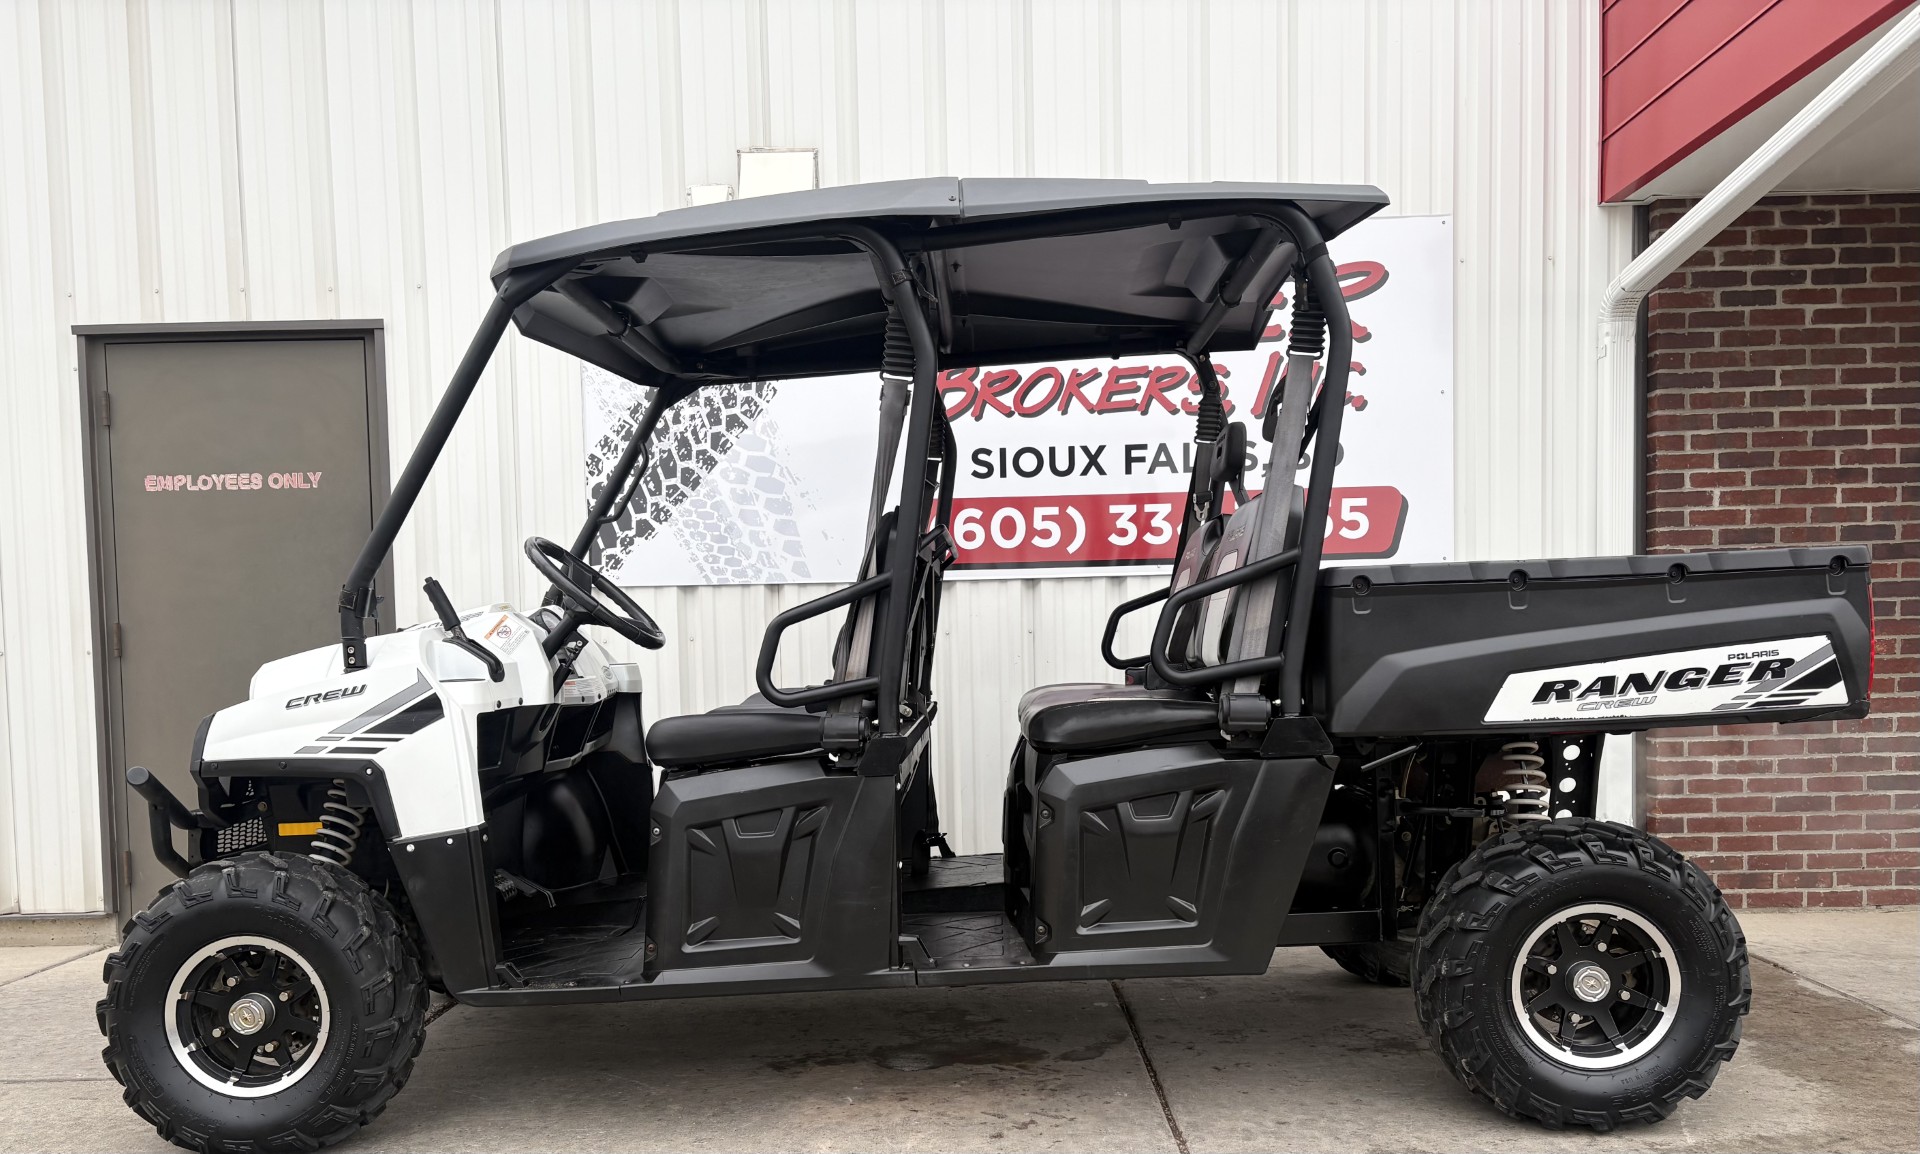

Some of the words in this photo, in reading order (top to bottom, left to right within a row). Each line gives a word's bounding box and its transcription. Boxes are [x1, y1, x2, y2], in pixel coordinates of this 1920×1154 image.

[937, 364, 1237, 424] BROKERS
[971, 443, 1107, 480] SIOUX
[1124, 440, 1271, 477] FALS,
[144, 473, 263, 492] EMPLOYEES
[267, 471, 323, 490] ONLY
[1727, 649, 1780, 661] POLARIS
[1530, 656, 1798, 705] RANGER
[285, 683, 368, 710] CREW
[1576, 695, 1658, 712] CREW
